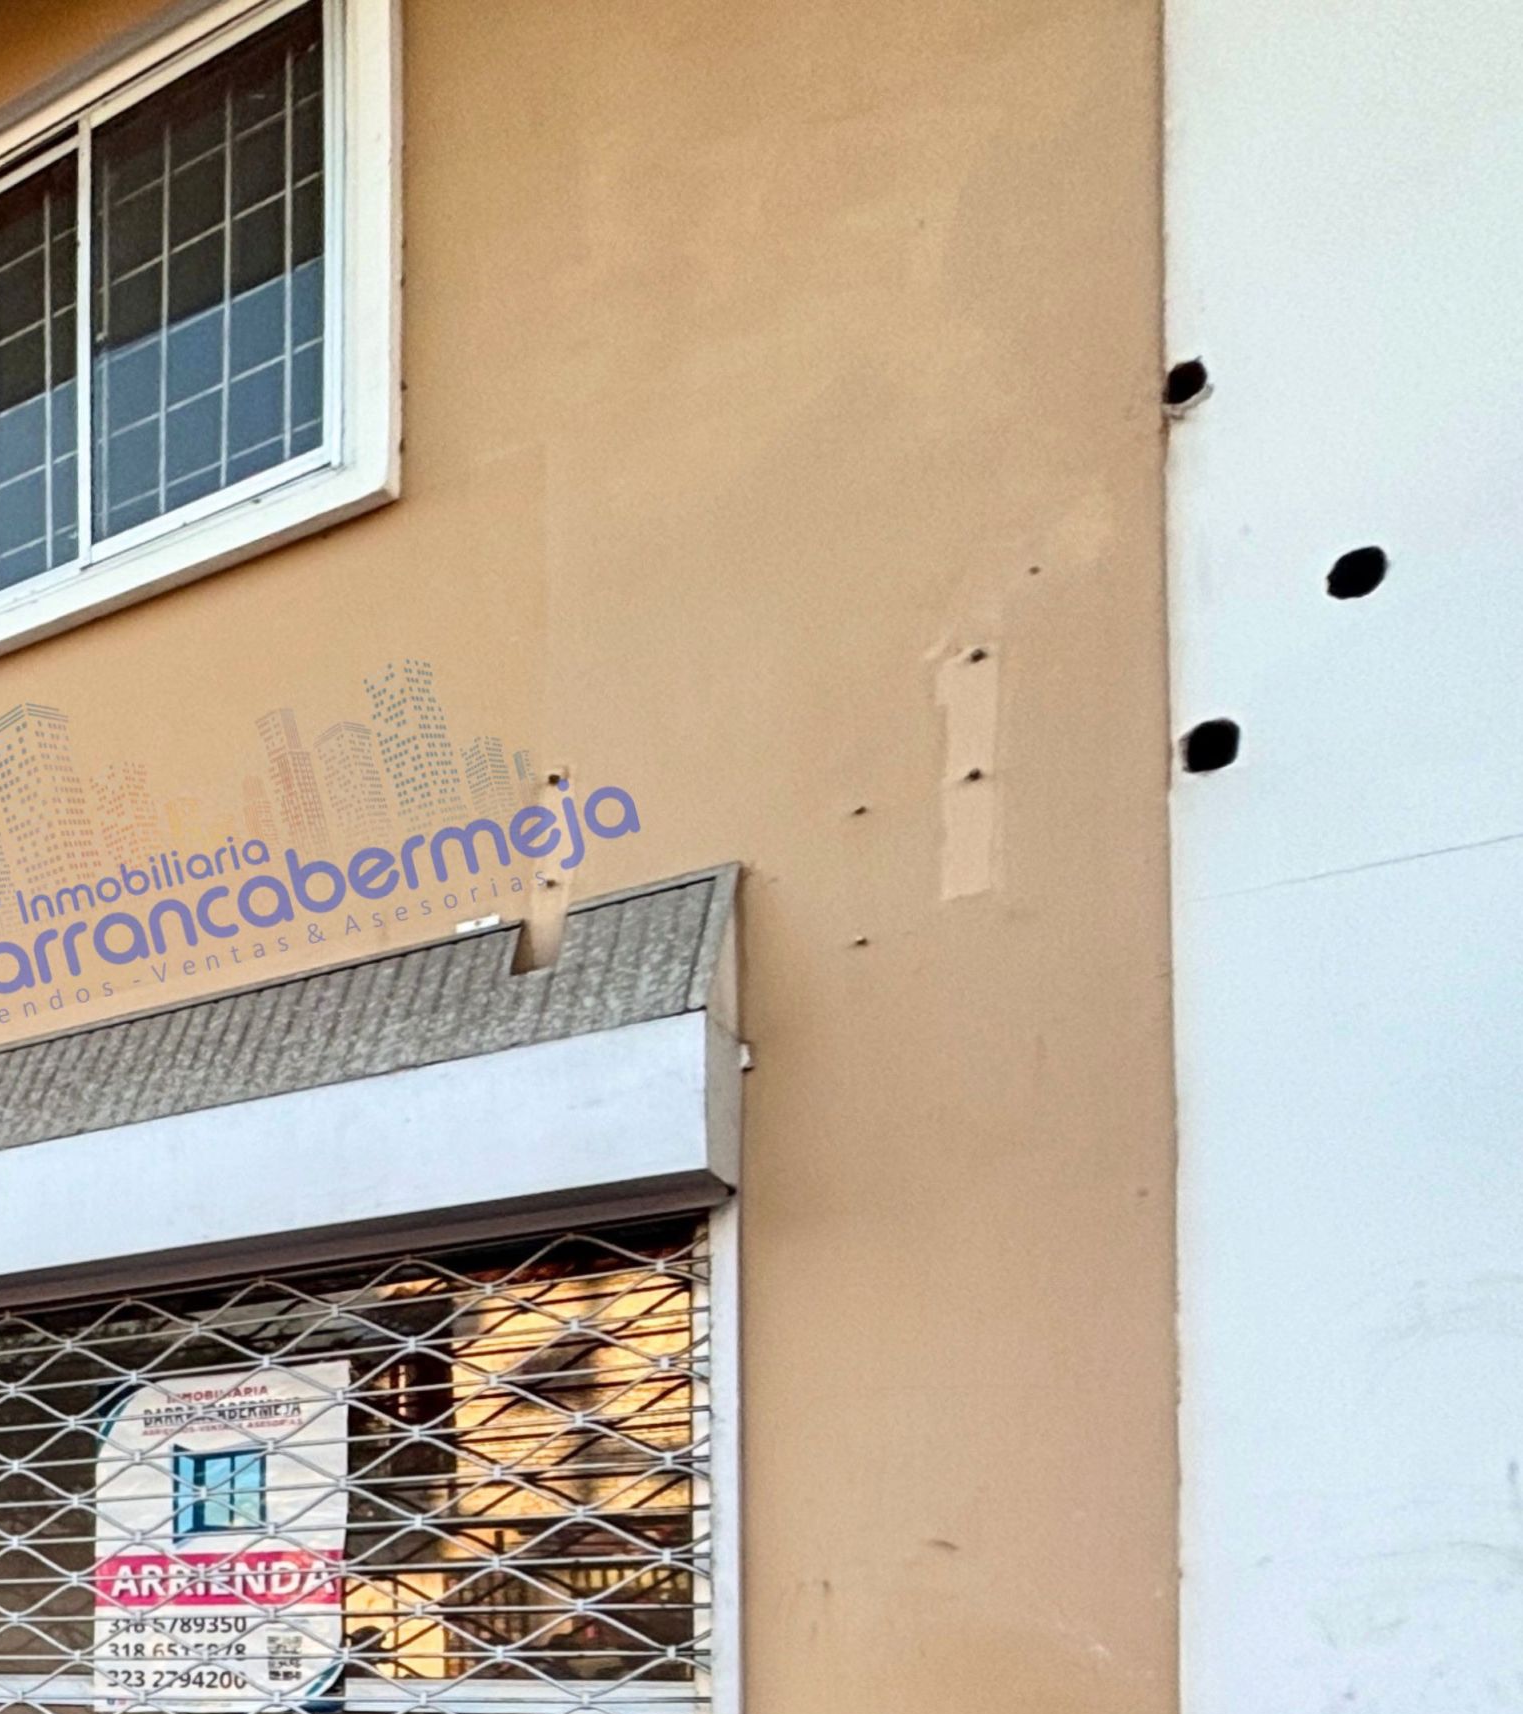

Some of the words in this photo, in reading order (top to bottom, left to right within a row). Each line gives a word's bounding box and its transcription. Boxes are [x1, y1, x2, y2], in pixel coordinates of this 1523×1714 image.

[167, 1385, 269, 1404] IMOBIARIA
[143, 1396, 302, 1427] BARRABERMEJA
[110, 1560, 336, 1598] ARRIENDA
[108, 1643, 145, 1660] 318
[153, 1643, 247, 1661] 65178
[107, 1670, 145, 1688] 323
[153, 1670, 247, 1689] 2794200
